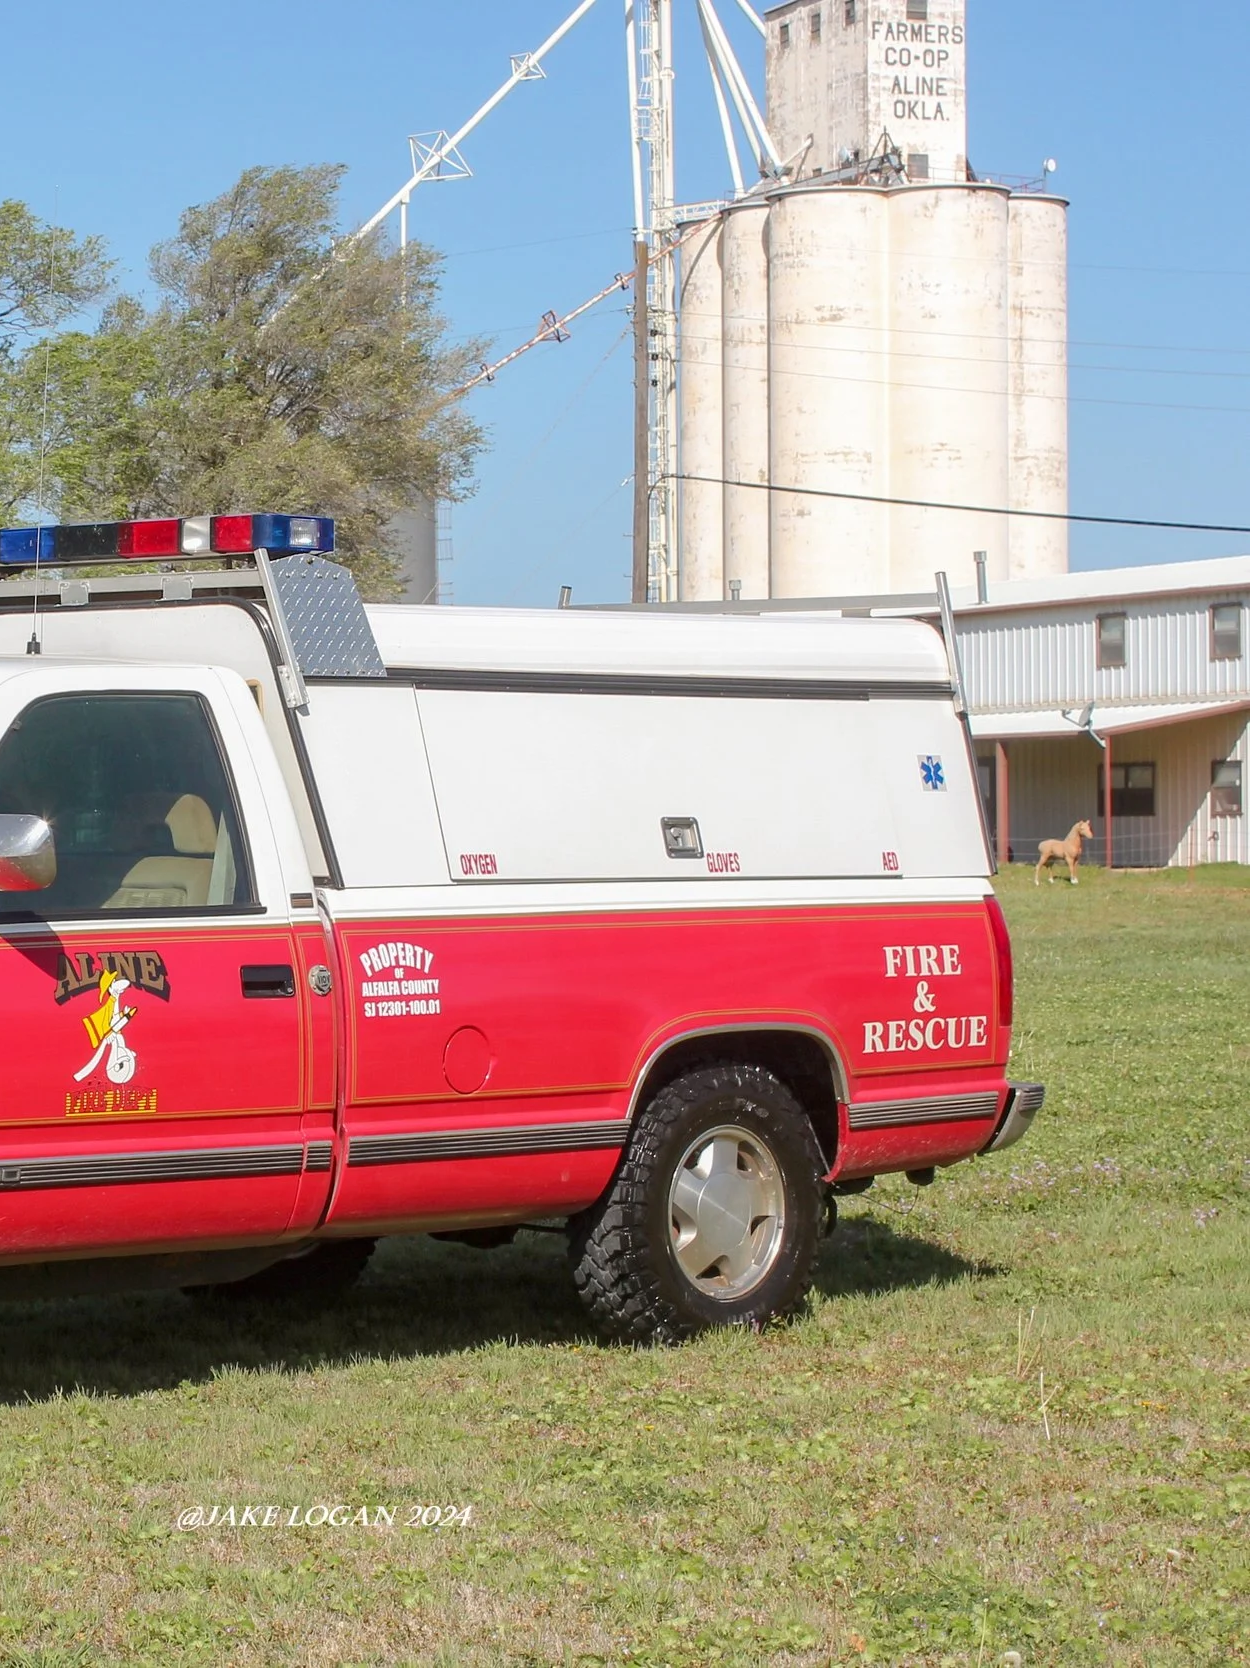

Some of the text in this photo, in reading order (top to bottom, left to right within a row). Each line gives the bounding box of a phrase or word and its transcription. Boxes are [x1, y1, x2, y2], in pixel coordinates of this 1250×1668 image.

[871, 21, 963, 44] FARMERS
[885, 47, 949, 68] CO-OP
[891, 75, 948, 96] ALINE
[894, 99, 950, 121] OKLA.
[460, 854, 498, 875] OXYGEN
[706, 852, 741, 873] GLOVES
[882, 852, 899, 871] AED
[359, 942, 434, 977] PROPERTY
[882, 944, 962, 977] FIRE
[54, 951, 171, 1006] ALINE
[394, 967, 405, 979] OF
[362, 979, 439, 997] ALFALFA COUNTY
[913, 980, 936, 1013] &
[377, 999, 441, 1016] 12301-100.01
[862, 1015, 987, 1054] RESCUE
